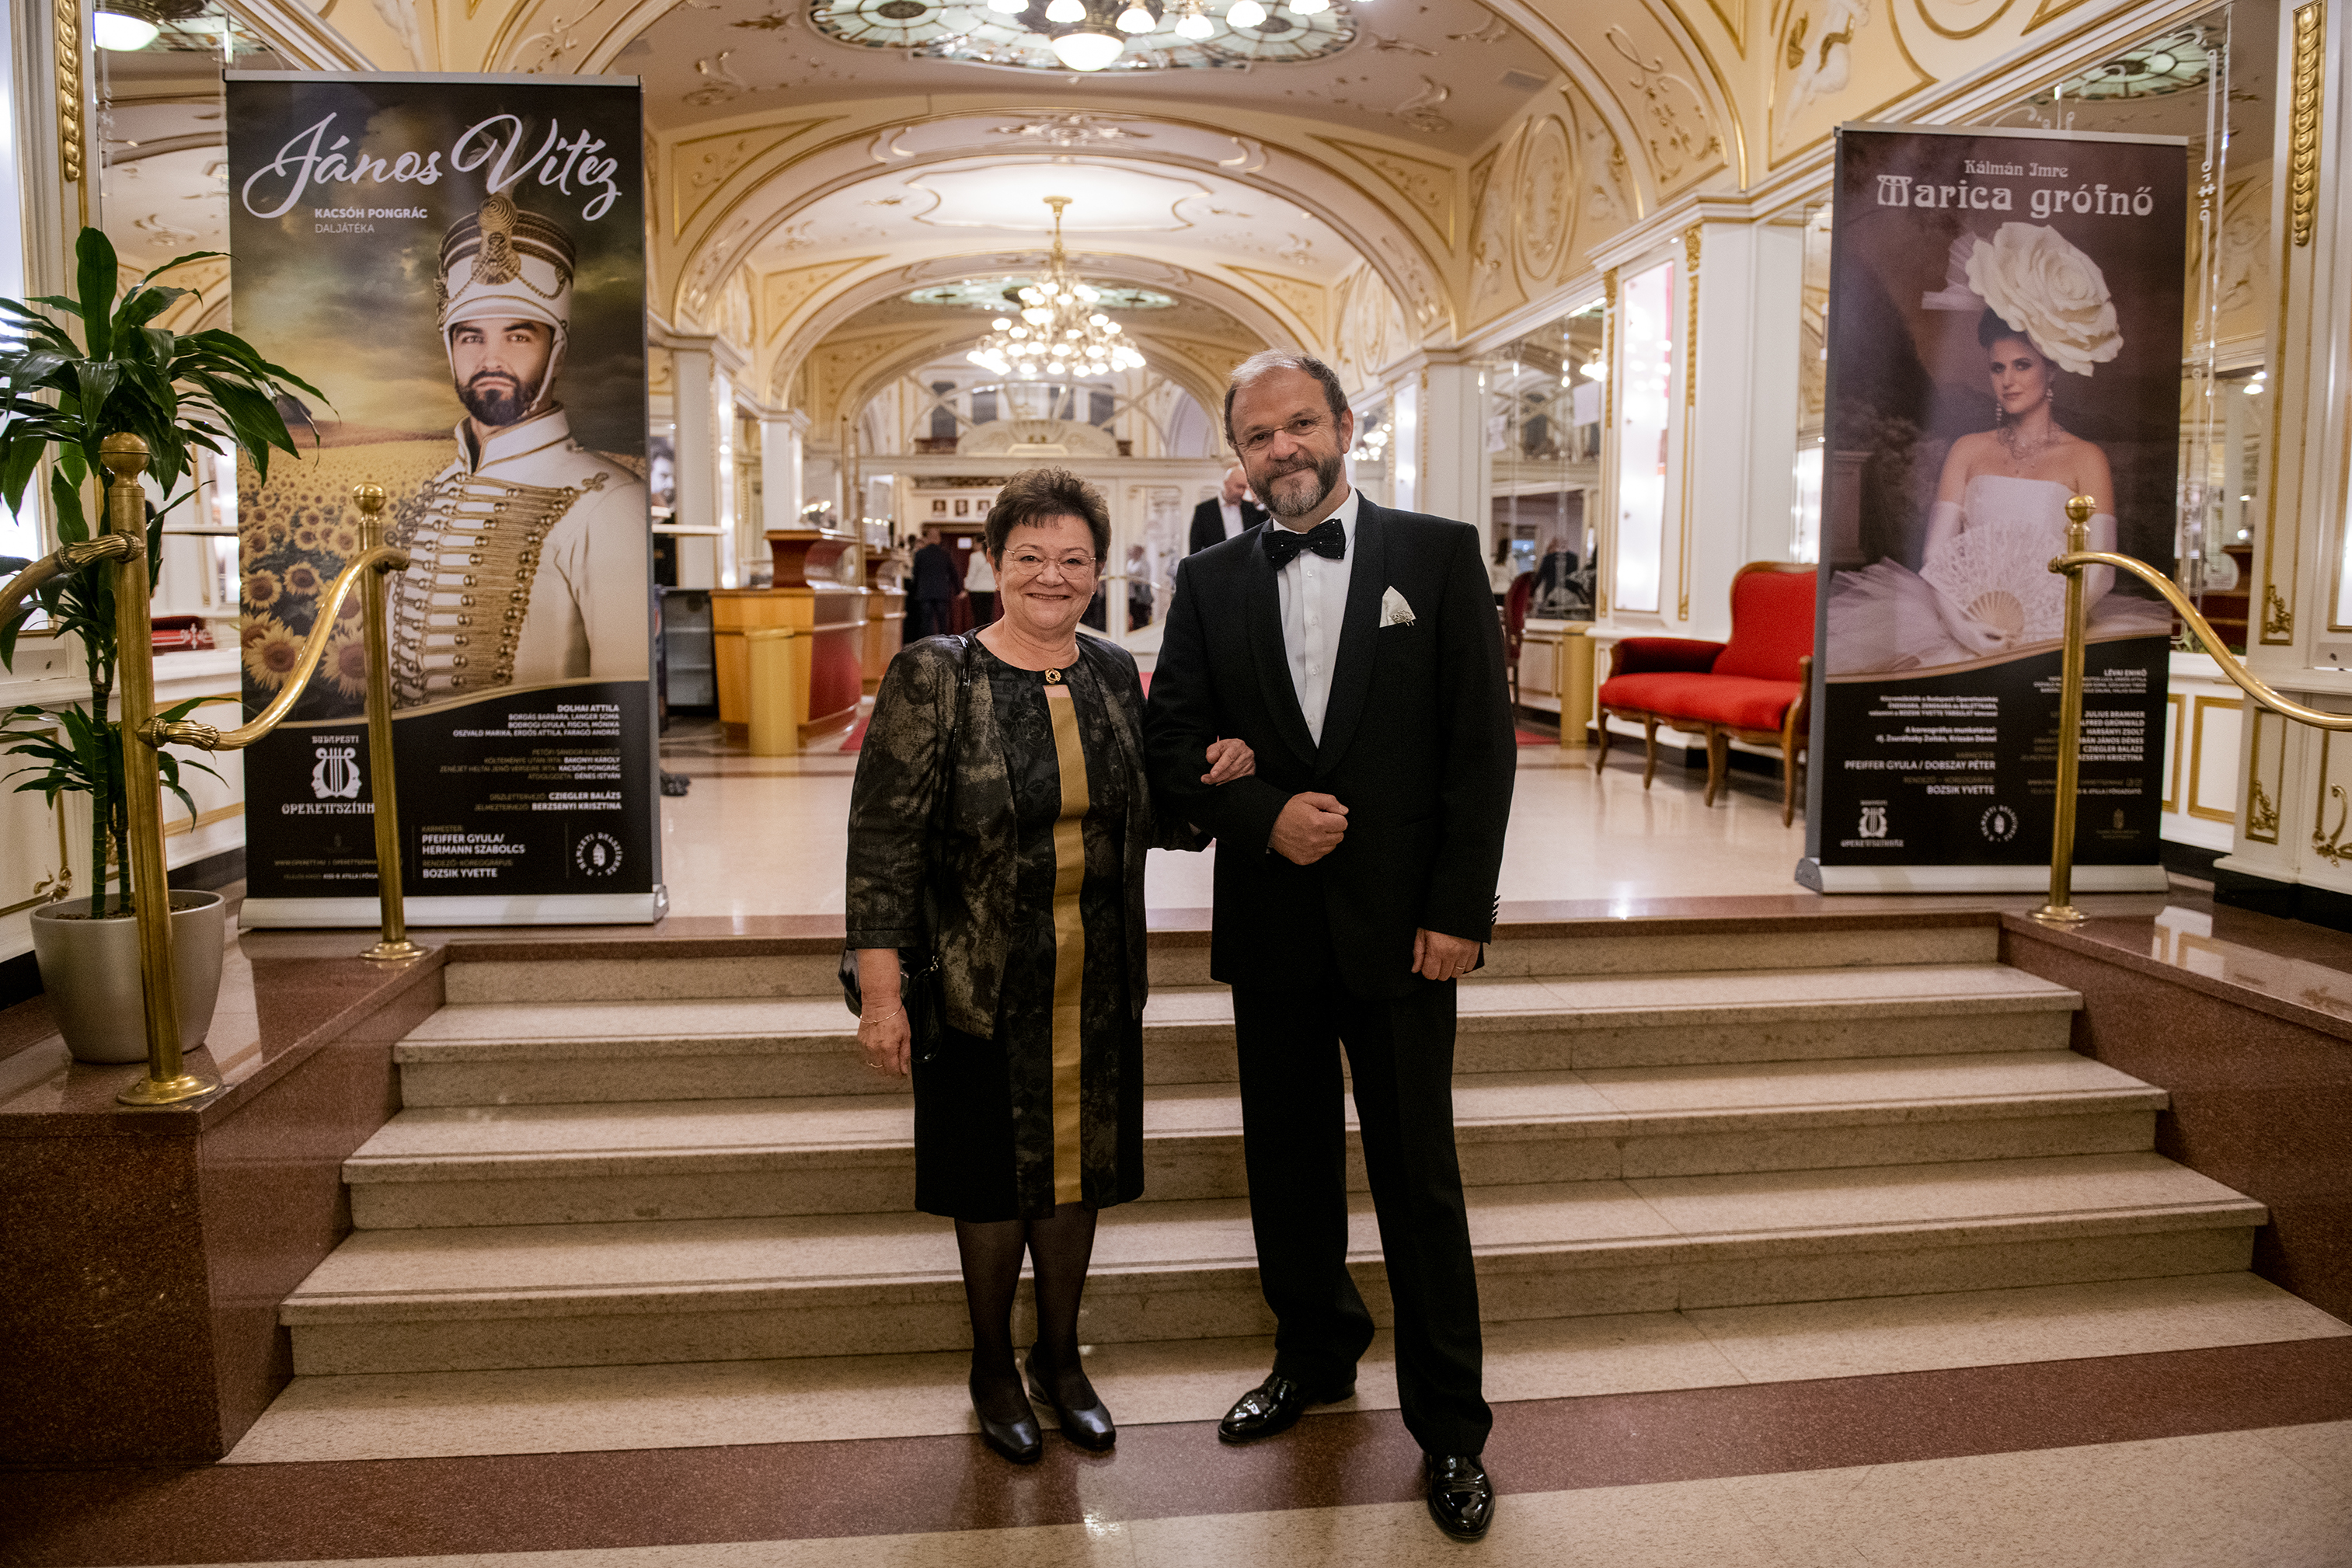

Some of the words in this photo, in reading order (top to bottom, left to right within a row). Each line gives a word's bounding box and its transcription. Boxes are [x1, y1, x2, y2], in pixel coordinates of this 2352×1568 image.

[242, 112, 443, 218] János
[451, 113, 622, 221] Vitéz
[1963, 159, 2023, 176] Kálmán
[2029, 162, 2069, 179] Imre
[1876, 174, 2012, 211] Marica
[2030, 183, 2154, 219] grófnő
[314, 207, 364, 219] KACSÓH
[368, 207, 428, 219] PONGRÁC
[314, 222, 375, 234] DALJÁTÉKA
[556, 704, 589, 713] DOLHAI
[590, 704, 620, 713] ATTILA
[452, 729, 484, 737] OSZVALD
[485, 729, 513, 737] MARIKA,
[592, 728, 620, 737] ANDRÁS
[312, 735, 360, 744] BUDAPESTI
[1844, 760, 1885, 770] PFEIFFER
[1886, 760, 1918, 770] GYULA
[1924, 760, 1967, 770] DOBSZAY
[1967, 758, 1996, 770] PÉTER
[596, 772, 622, 780] ISTVÁN
[548, 791, 590, 800] CZIEGLER
[590, 790, 622, 800] BALÁZS
[1926, 785, 1960, 795] BOZSIK
[1960, 785, 1995, 795] YVETTE
[281, 801, 375, 815] OPERETTSZÍNH
[531, 802, 577, 811] BERZSENYI
[577, 801, 623, 811] KRISZTINA
[421, 834, 465, 845] PFEIFFER
[466, 834, 506, 844] GYULA/
[421, 845, 473, 855] HERMANN
[473, 844, 527, 855] SZABOLCS
[422, 868, 460, 879] BOZSIK
[460, 867, 499, 878] YVETTE
